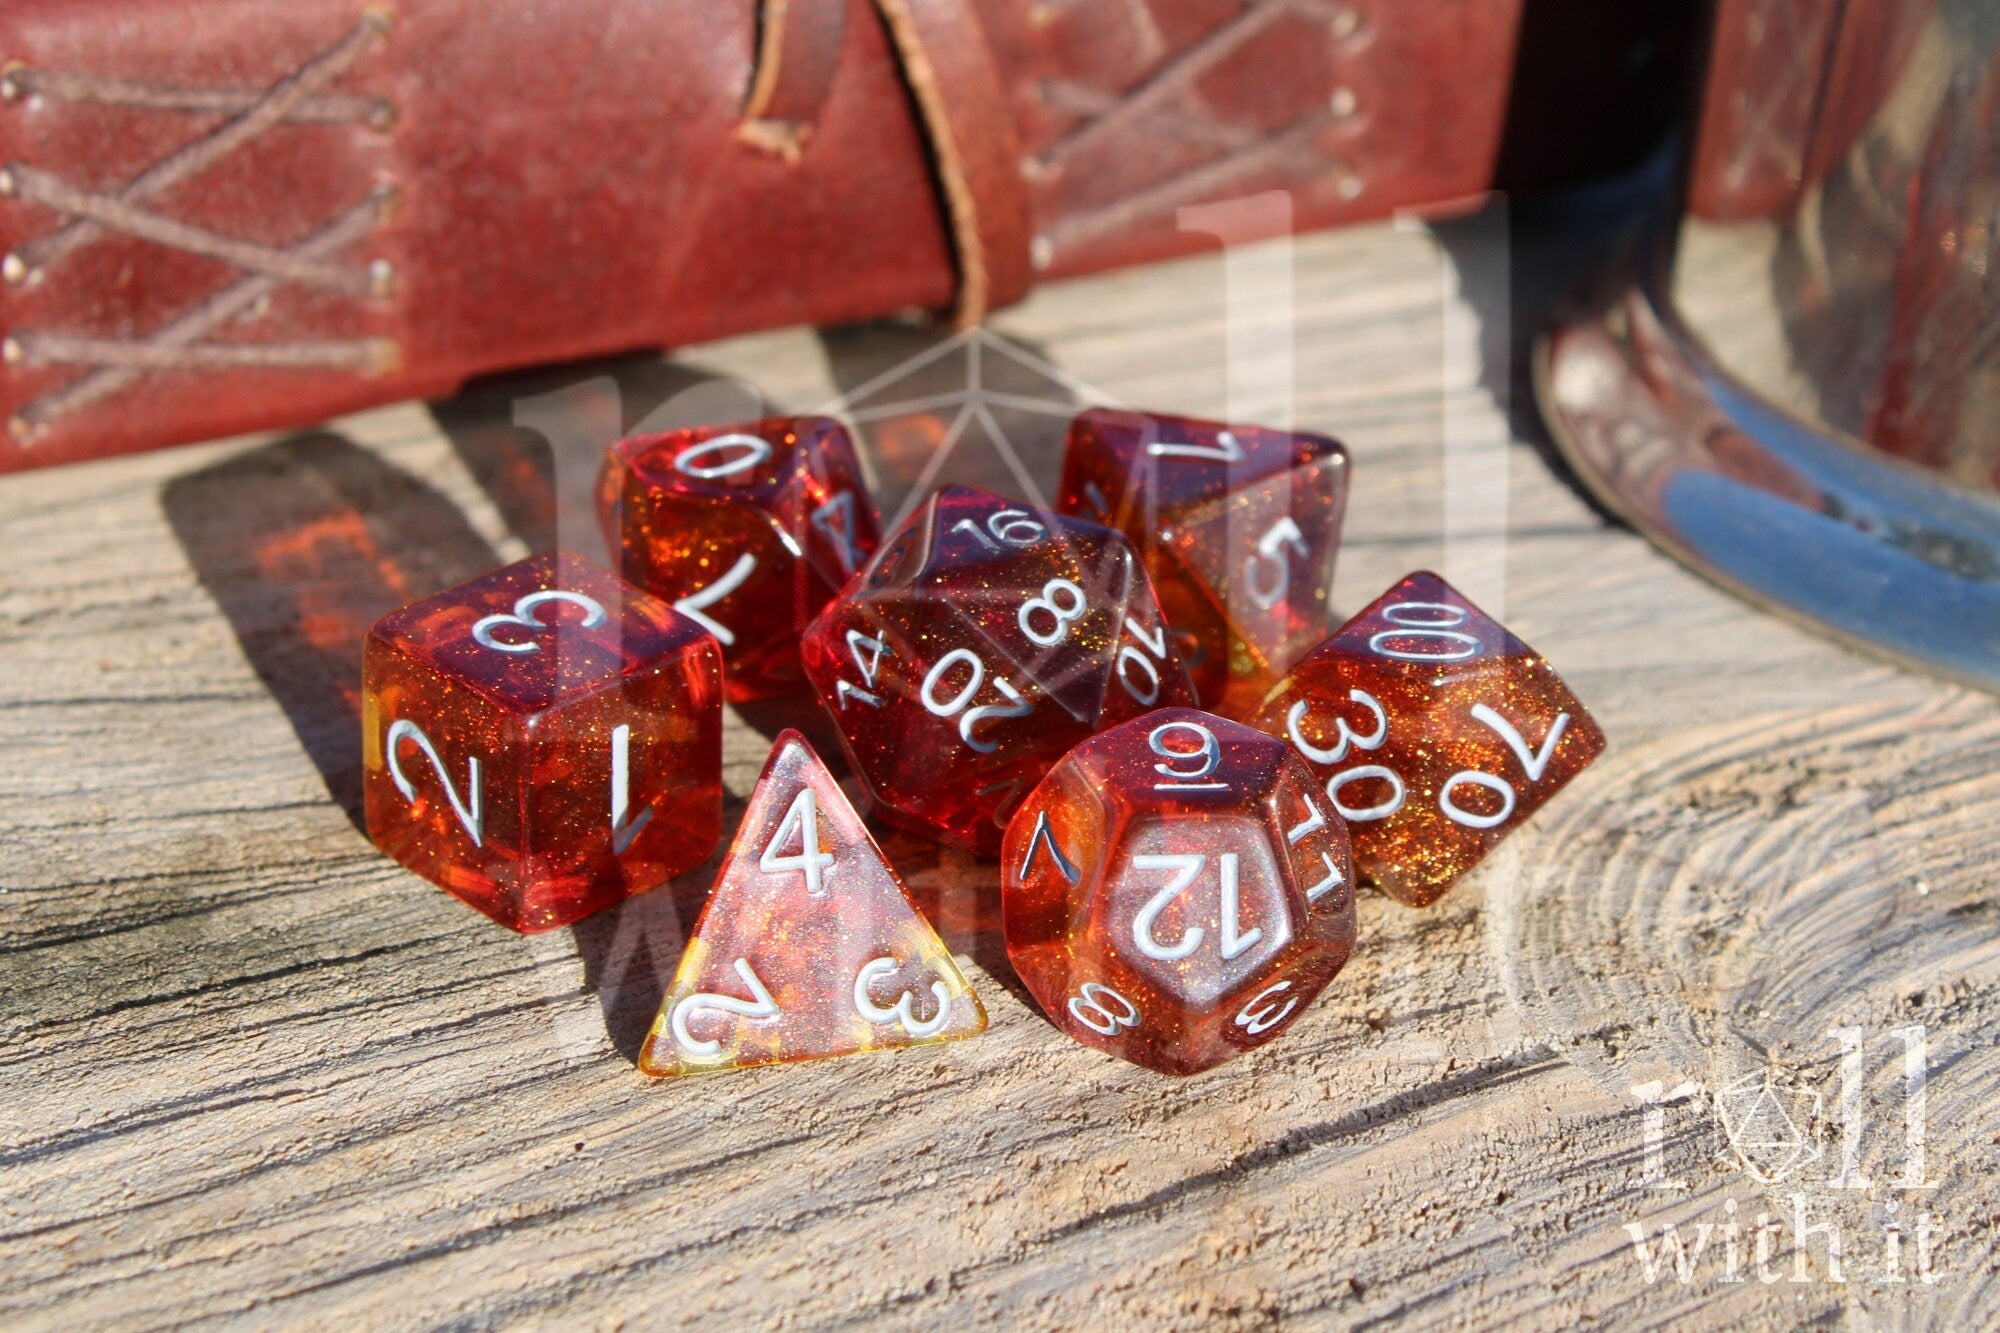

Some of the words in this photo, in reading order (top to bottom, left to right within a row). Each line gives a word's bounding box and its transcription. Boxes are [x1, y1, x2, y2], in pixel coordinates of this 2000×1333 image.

[674, 434, 772, 478] 0
[1146, 431, 1246, 462] 1
[951, 508, 1046, 550] 16
[1245, 516, 1308, 611] 5
[471, 590, 606, 652] 3
[673, 553, 757, 646] 7
[1018, 579, 1088, 647] 8
[1369, 602, 1484, 661] 00
[836, 629, 893, 712] 14
[920, 648, 1034, 753] 20
[1116, 616, 1167, 706] 10
[387, 719, 482, 848] 2
[611, 724, 654, 856] 1
[1149, 721, 1229, 791] 9
[1286, 689, 1406, 822] 30
[1440, 702, 1570, 829] 70
[760, 788, 835, 892] 4
[1020, 810, 1082, 886] 7
[1287, 793, 1346, 904] 11
[1132, 852, 1264, 961] 12
[672, 957, 780, 1056] 2
[854, 957, 951, 1036] 3
[1068, 982, 1143, 1037] 8
[1234, 980, 1302, 1035] 3
